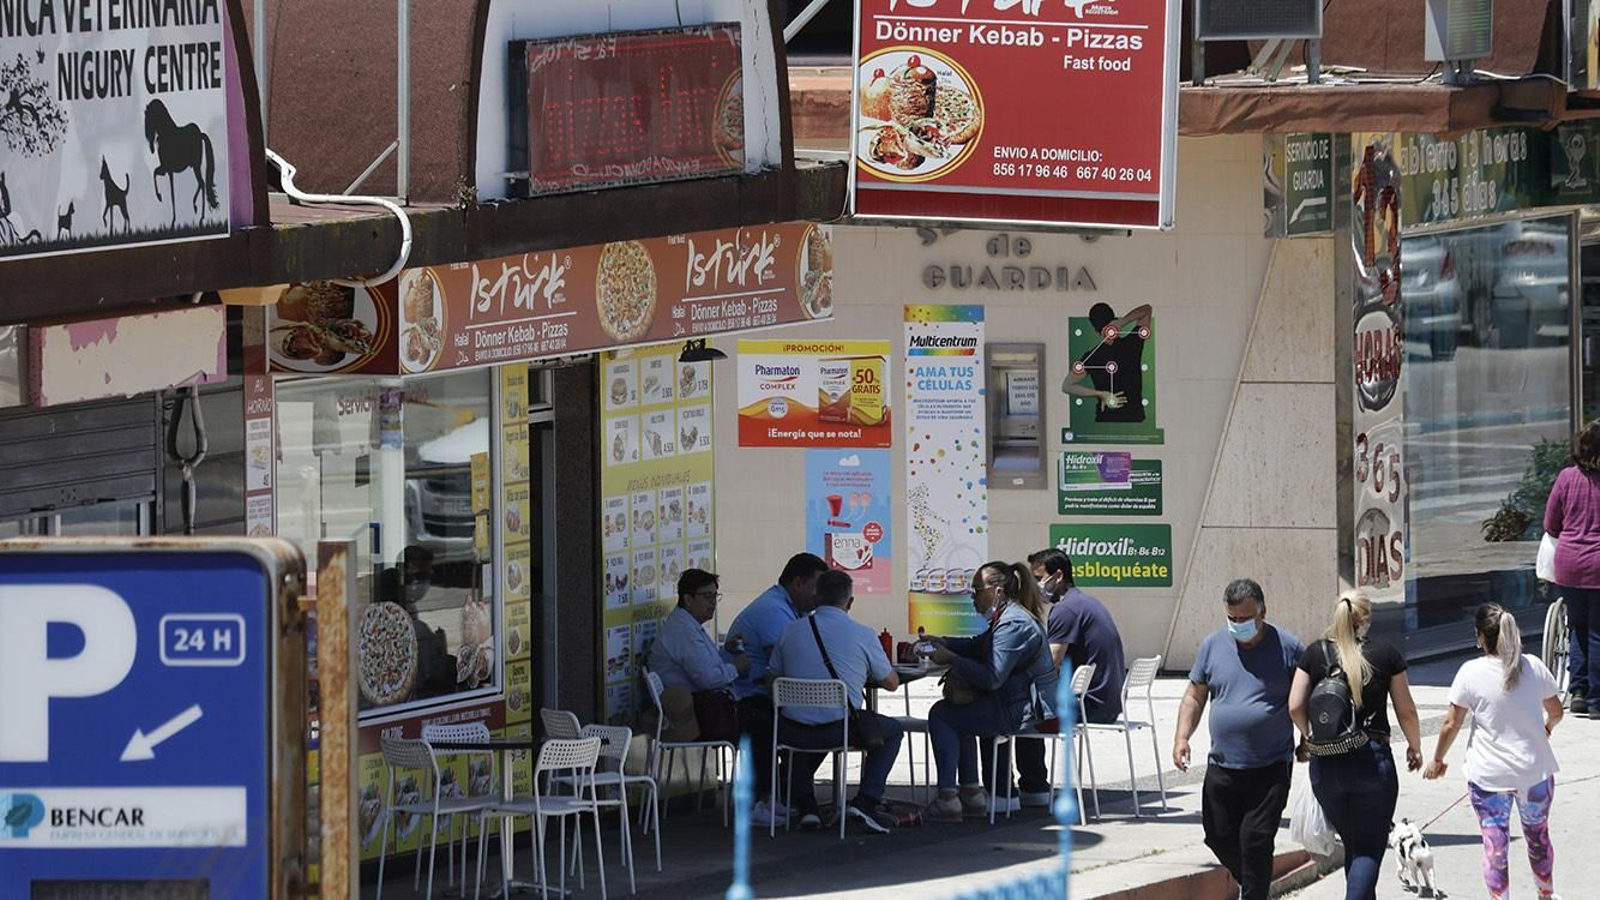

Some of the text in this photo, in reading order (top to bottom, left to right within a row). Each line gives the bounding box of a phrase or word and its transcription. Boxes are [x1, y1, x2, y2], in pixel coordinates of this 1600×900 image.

[0, 0, 55, 38] NICA
[876, 20, 963, 44] Dönner
[968, 23, 1045, 47] Kebab
[1067, 28, 1143, 51] Pizzas
[57, 41, 222, 102] NIGURY CENTRE
[1063, 55, 1131, 72] Fast food
[993, 146, 1103, 163] ENVIO A DOMICILIO:
[1286, 139, 1330, 163] SERVICIO DE
[1400, 129, 1528, 176] abierto 13 horas
[993, 164, 1153, 182] 856 17 96 46 667 40 26 04
[1292, 169, 1325, 191] GUARDIA
[1431, 177, 1459, 217] 365
[986, 233, 1032, 258] de
[921, 264, 1098, 291] GUARDIA
[691, 303, 720, 320] Dönner
[721, 299, 748, 318] Kebab
[753, 297, 779, 314] Pizzas
[474, 330, 507, 348] Dönner
[507, 324, 536, 344] Kebab
[541, 321, 569, 339] Pizzas
[909, 335, 977, 348] Multicentrum
[782, 343, 845, 354] ¡PROMOCIÓN!
[1355, 325, 1401, 385] HORAS
[754, 364, 801, 376] Pharmaton
[819, 366, 849, 375] Pharmaton
[915, 366, 975, 378] AMA TUS
[759, 383, 797, 391] COMPLEX
[852, 384, 881, 395] GRATIS
[767, 427, 862, 441] ¡Energía que se nota!
[1065, 454, 1104, 465] Hidroxil
[1356, 432, 1401, 503] 365
[834, 537, 861, 549] enna
[1056, 537, 1129, 556] Hidroxil
[1357, 530, 1403, 588] DIAS
[1072, 561, 1169, 582] esbloquéate
[173, 628, 231, 652] 24 H
[0, 583, 137, 762] P
[50, 805, 146, 829] BENCAR
